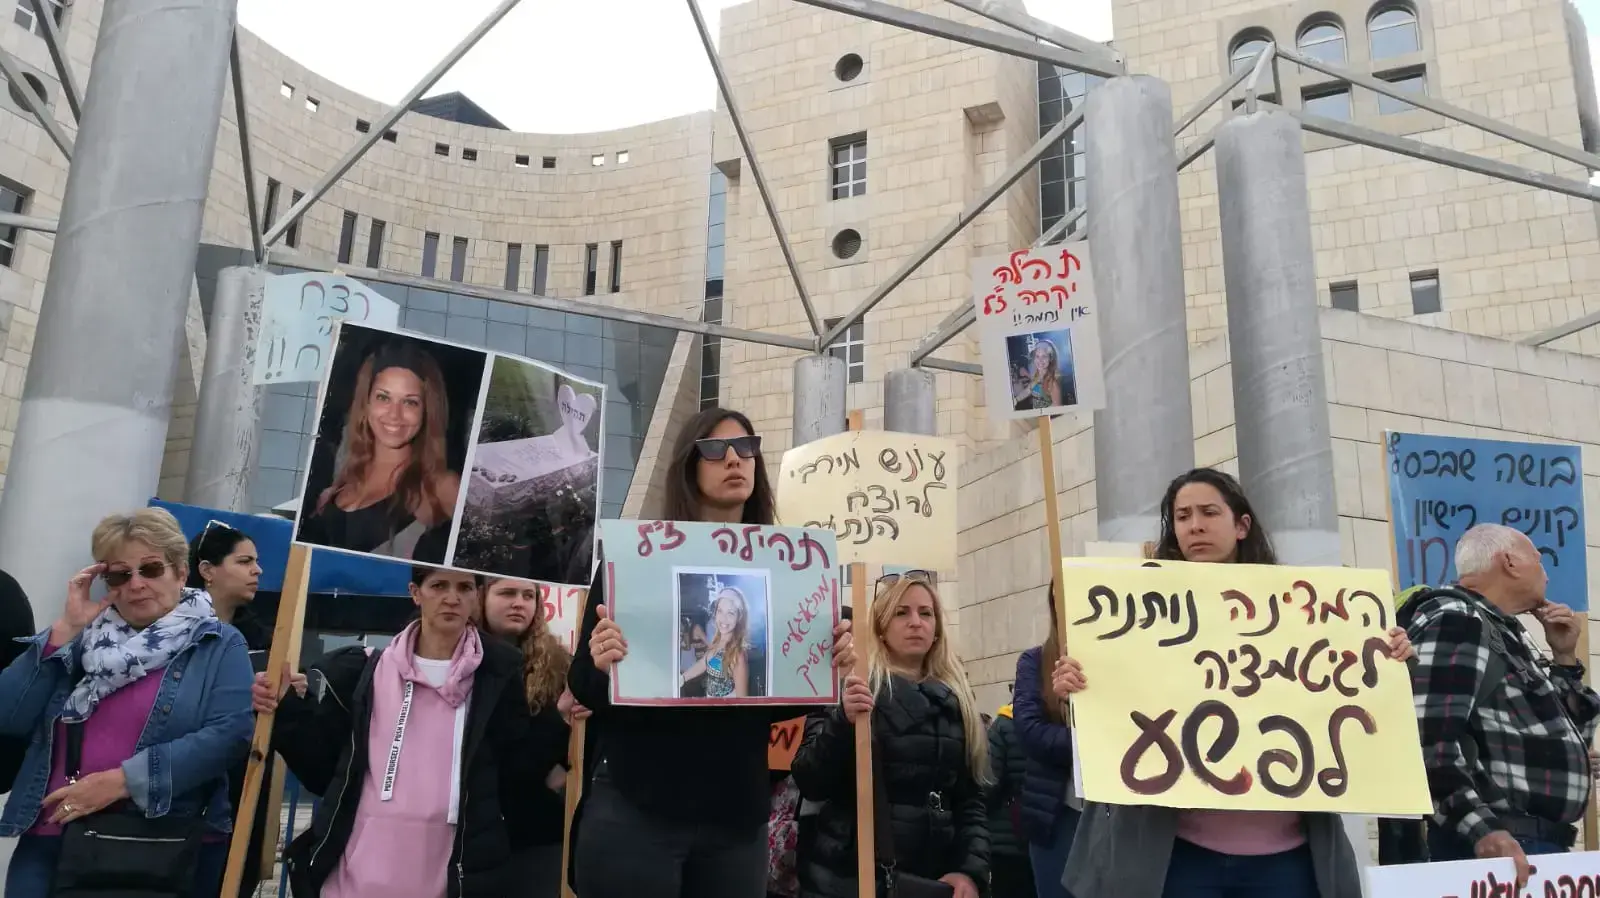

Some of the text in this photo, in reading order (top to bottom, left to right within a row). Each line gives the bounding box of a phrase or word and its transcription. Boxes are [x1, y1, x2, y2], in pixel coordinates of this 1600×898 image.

[300, 280, 370, 320] רצח
[1017, 282, 1077, 309] יקרה
[1070, 305, 1091, 321] אין
[562, 401, 585, 422] תהילה
[790, 446, 946, 484] עונש מירבי
[1494, 452, 1576, 488] בושה
[1501, 505, 1579, 547] קונים
[711, 526, 831, 571] תהילה
[1072, 580, 1387, 647] המדינה נותנת
[1194, 637, 1392, 698] לגיטמציה
[395, 724, 403, 742] PUSH
[1120, 699, 1378, 798] לפשע
[387, 746, 399, 775] YOURSELF
[384, 774, 392, 792] PUSH
